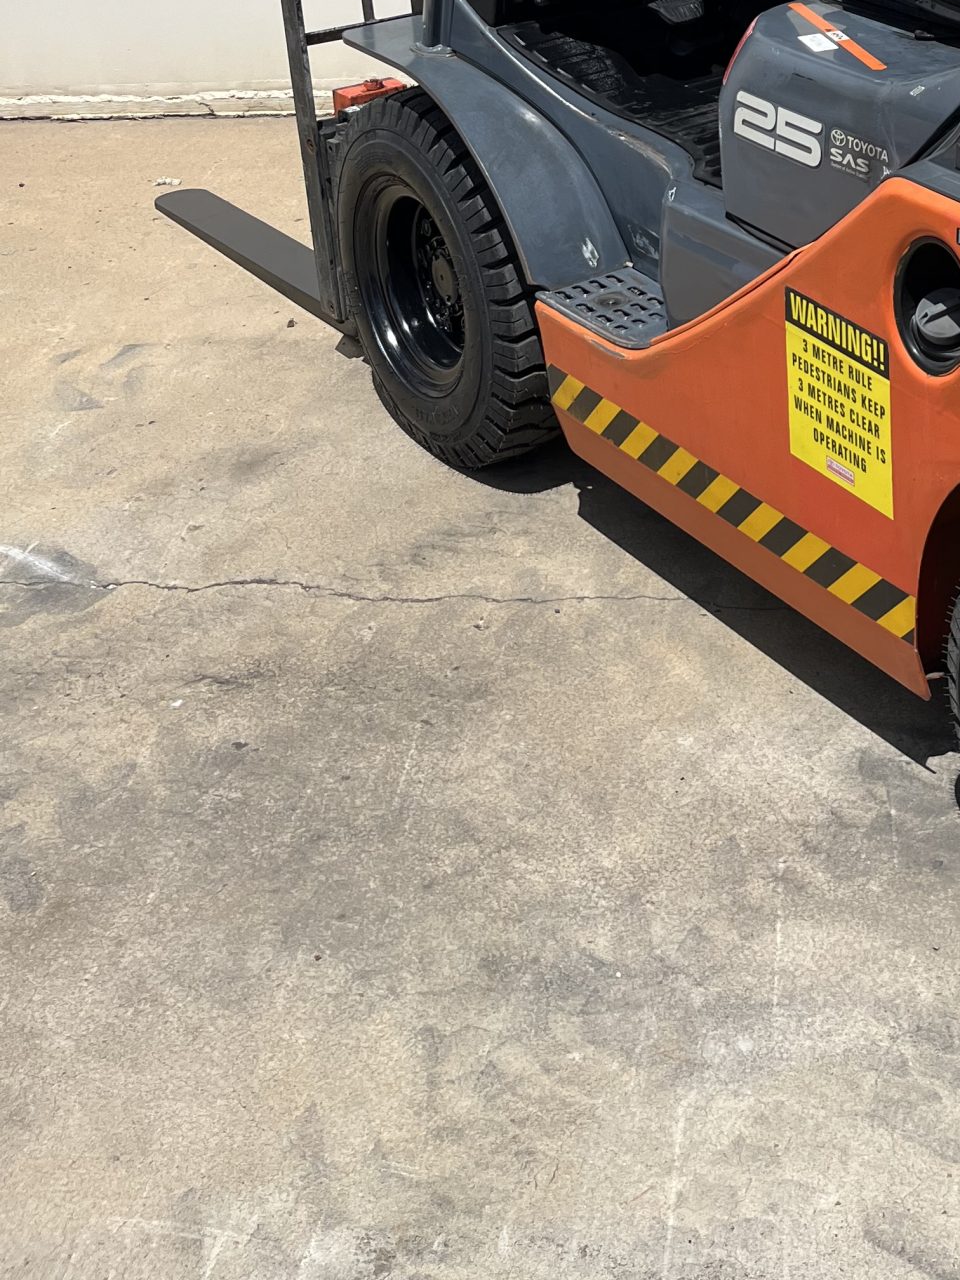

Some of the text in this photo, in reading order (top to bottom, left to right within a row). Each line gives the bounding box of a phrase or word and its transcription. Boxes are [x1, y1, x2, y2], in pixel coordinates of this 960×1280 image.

[733, 90, 822, 167] 25
[846, 135, 889, 163] TOYOTA
[829, 147, 870, 173] SAS
[789, 291, 885, 371] WARNING!!
[791, 352, 886, 420] PEDESTRIANS KEEP
[802, 338, 873, 391] 3 METRE RULE
[793, 394, 886, 464] WHEN MACHINE IS
[798, 377, 880, 439] 3 METRES CLEAR
[813, 427, 867, 473] OPERATING
